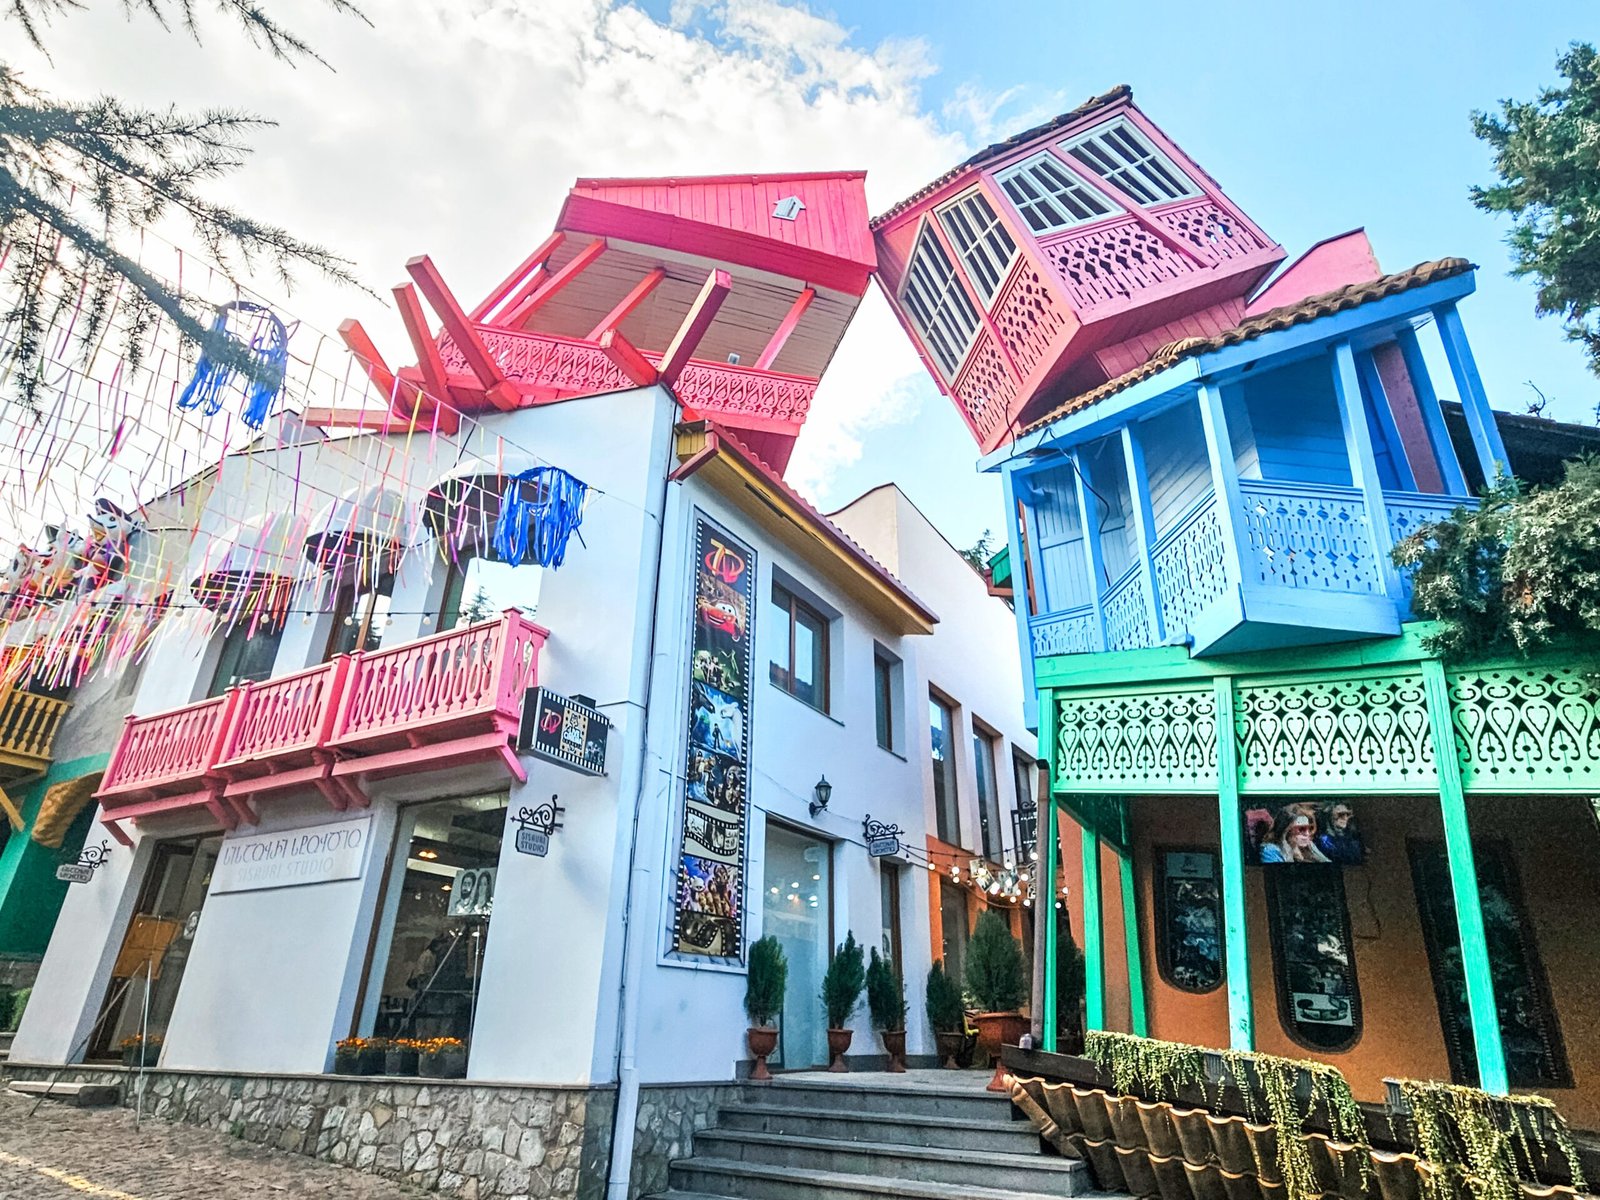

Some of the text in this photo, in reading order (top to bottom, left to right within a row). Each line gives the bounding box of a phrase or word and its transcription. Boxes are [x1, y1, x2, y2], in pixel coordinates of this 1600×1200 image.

[541, 708, 561, 734] 7D
[520, 841, 544, 853] STUDIO
[287, 857, 334, 876] STUDIO
